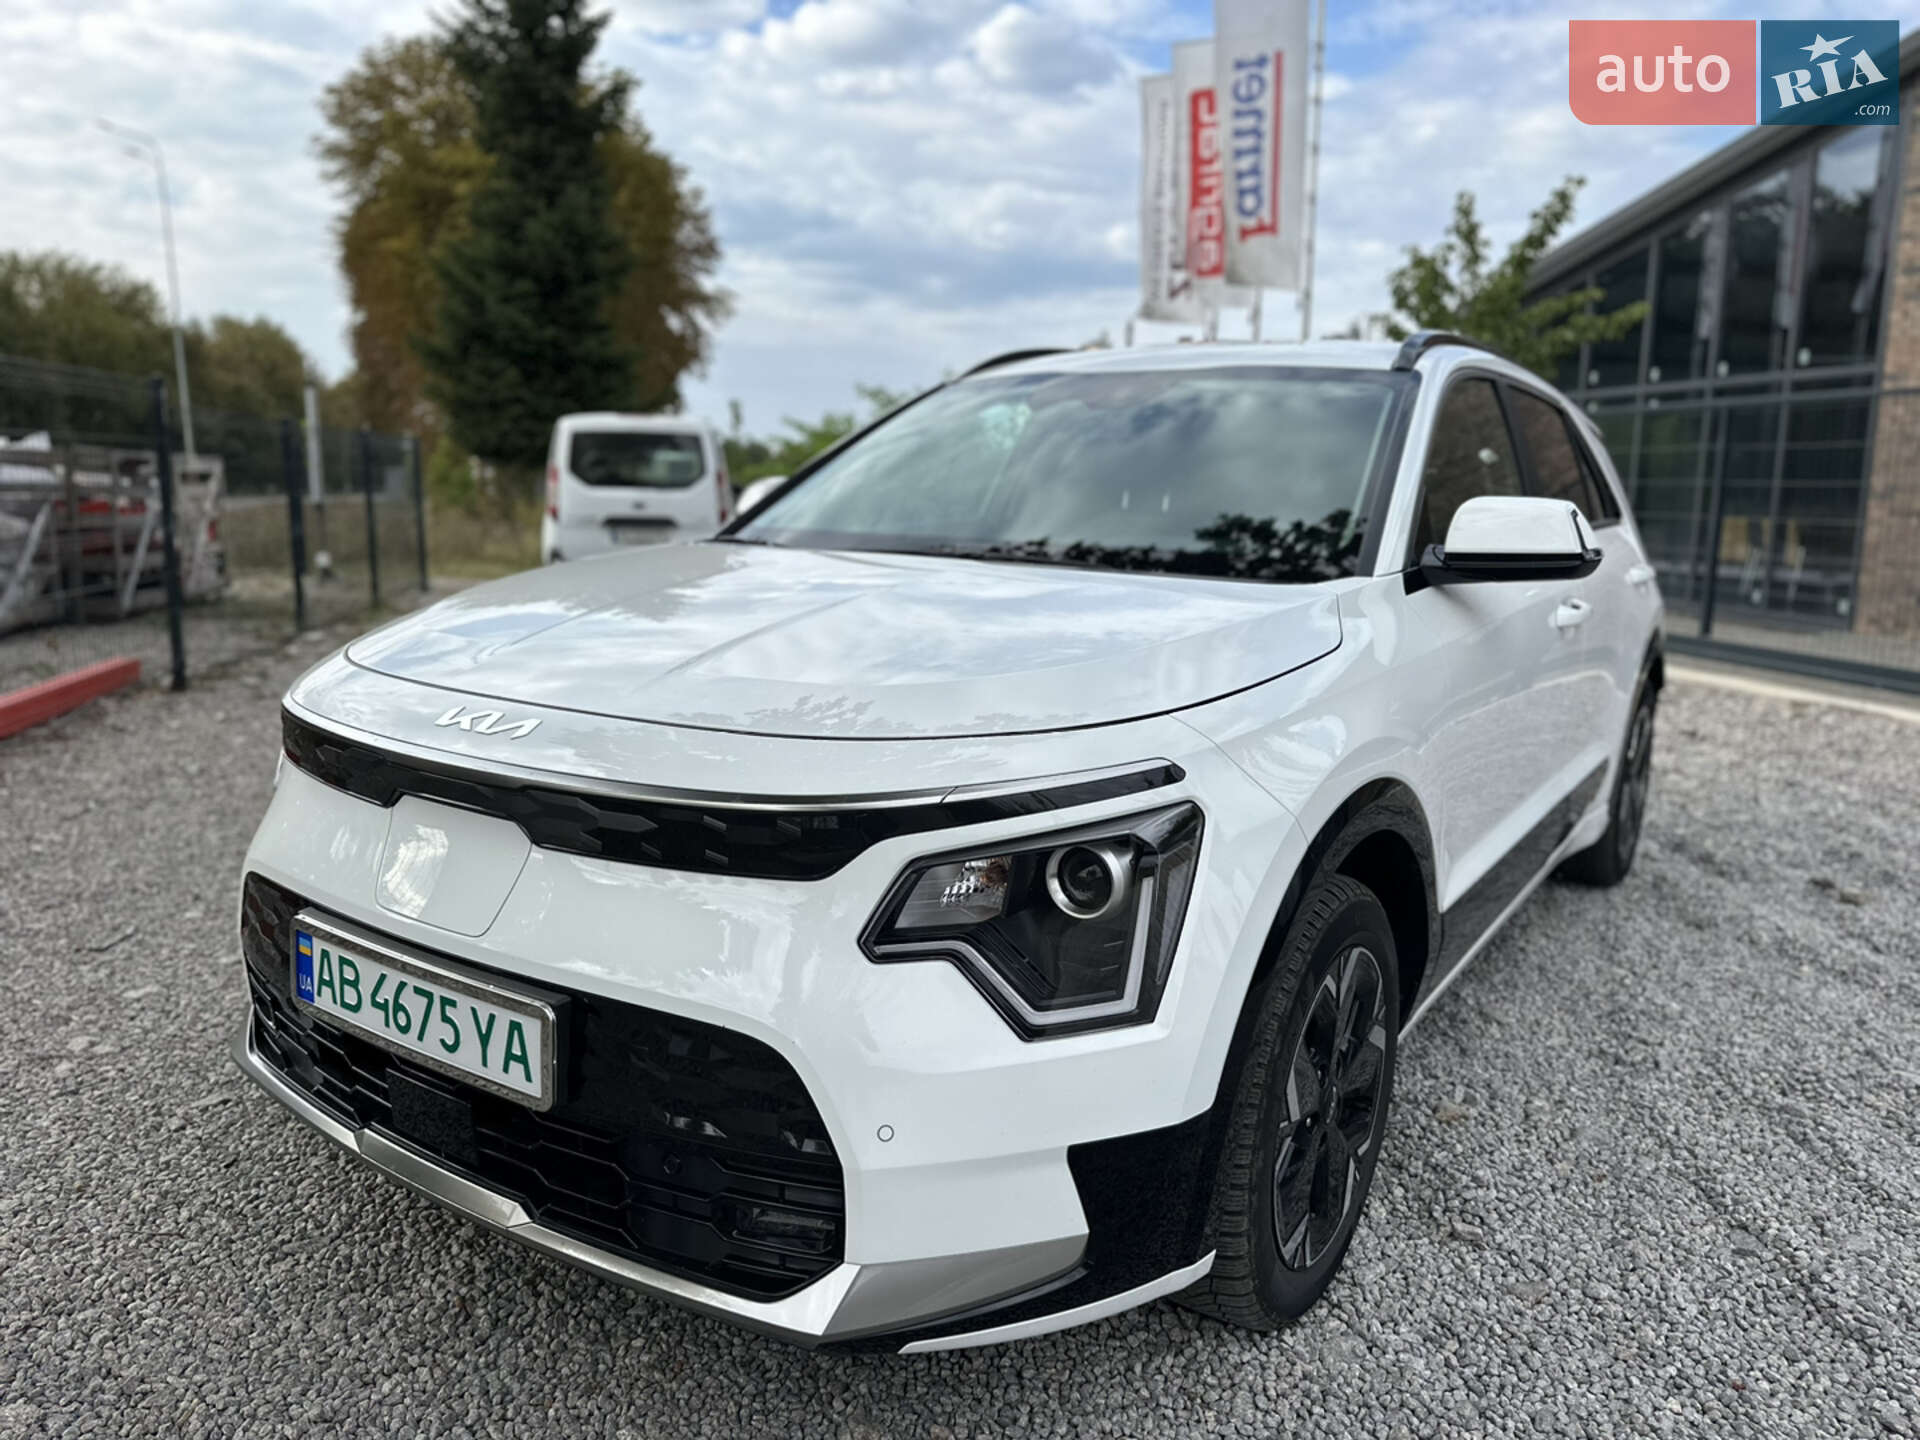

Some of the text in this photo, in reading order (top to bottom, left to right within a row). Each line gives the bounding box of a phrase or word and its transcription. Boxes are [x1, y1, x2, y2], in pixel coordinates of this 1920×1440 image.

[434, 705, 543, 740] KIA
[299, 973, 313, 993] UA
[316, 947, 533, 1083] AB 4675 YA
